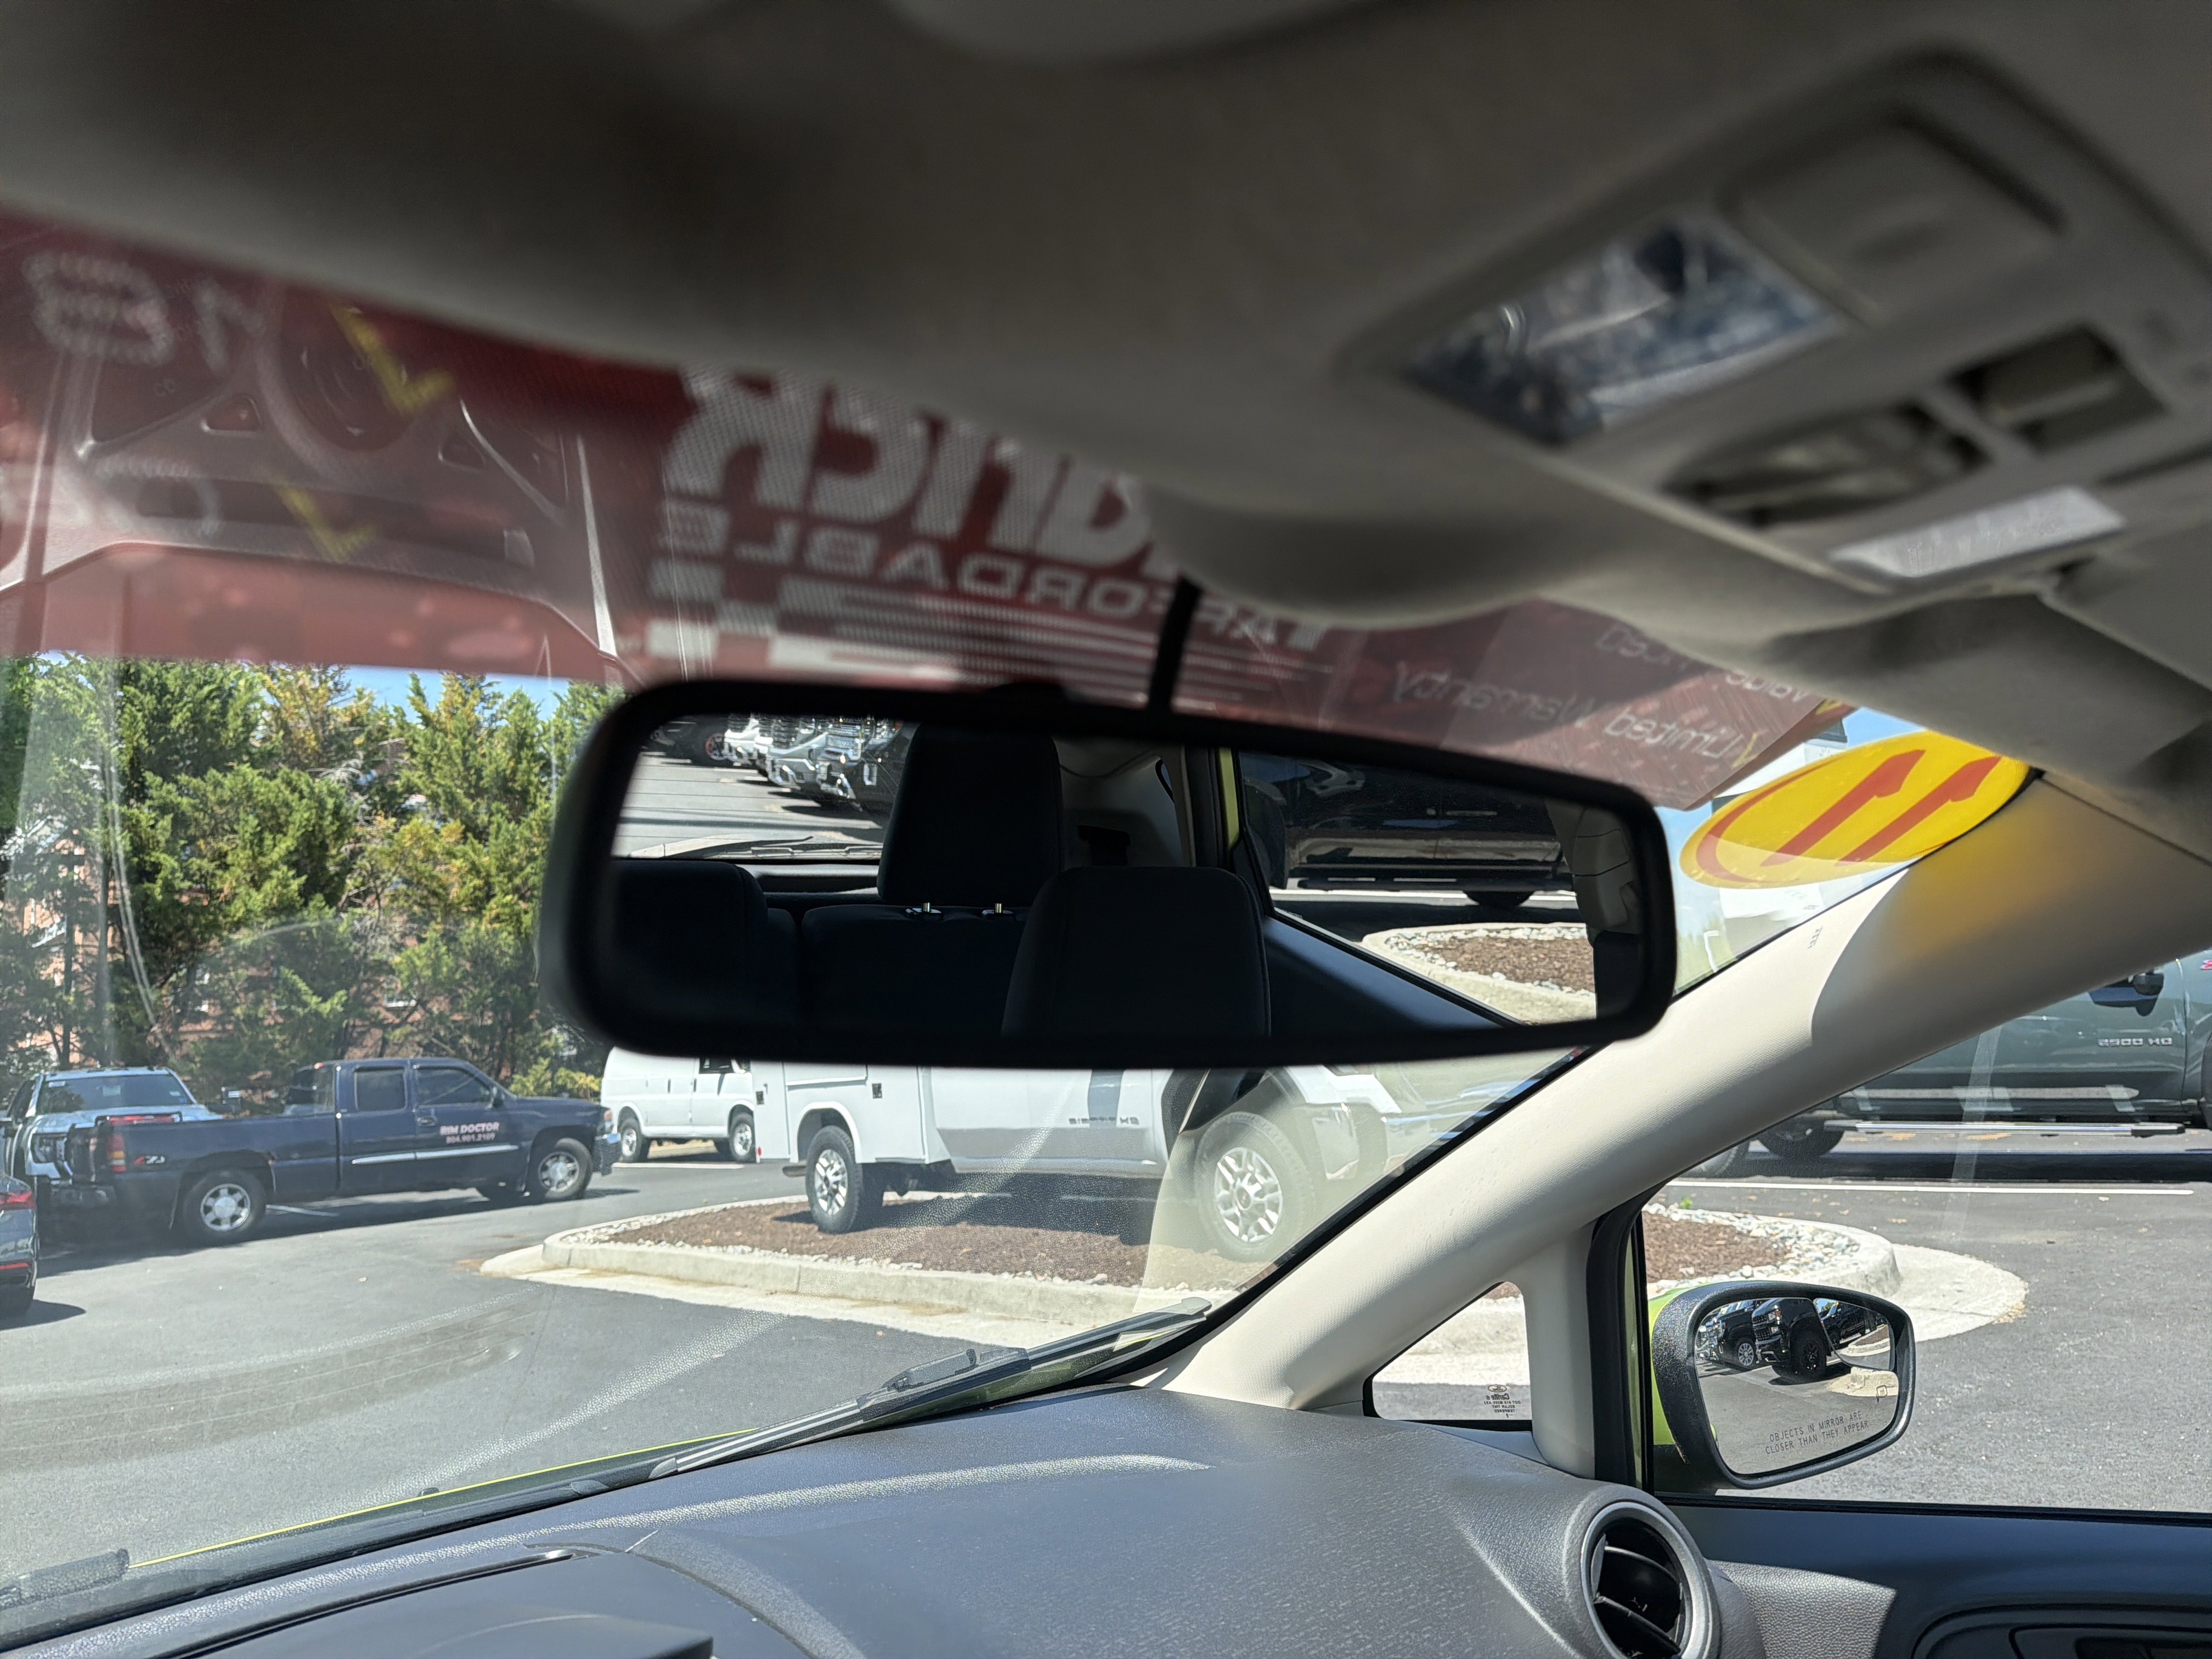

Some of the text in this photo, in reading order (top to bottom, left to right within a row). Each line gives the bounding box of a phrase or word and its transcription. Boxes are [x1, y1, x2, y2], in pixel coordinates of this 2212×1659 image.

[439, 1121, 500, 1136] RIM DOCTOR
[1765, 1420, 1869, 1454] CLOSER THAN THEY APPEAR
[1769, 1410, 1863, 1442] OBJECTS IN MIRROR ARE
